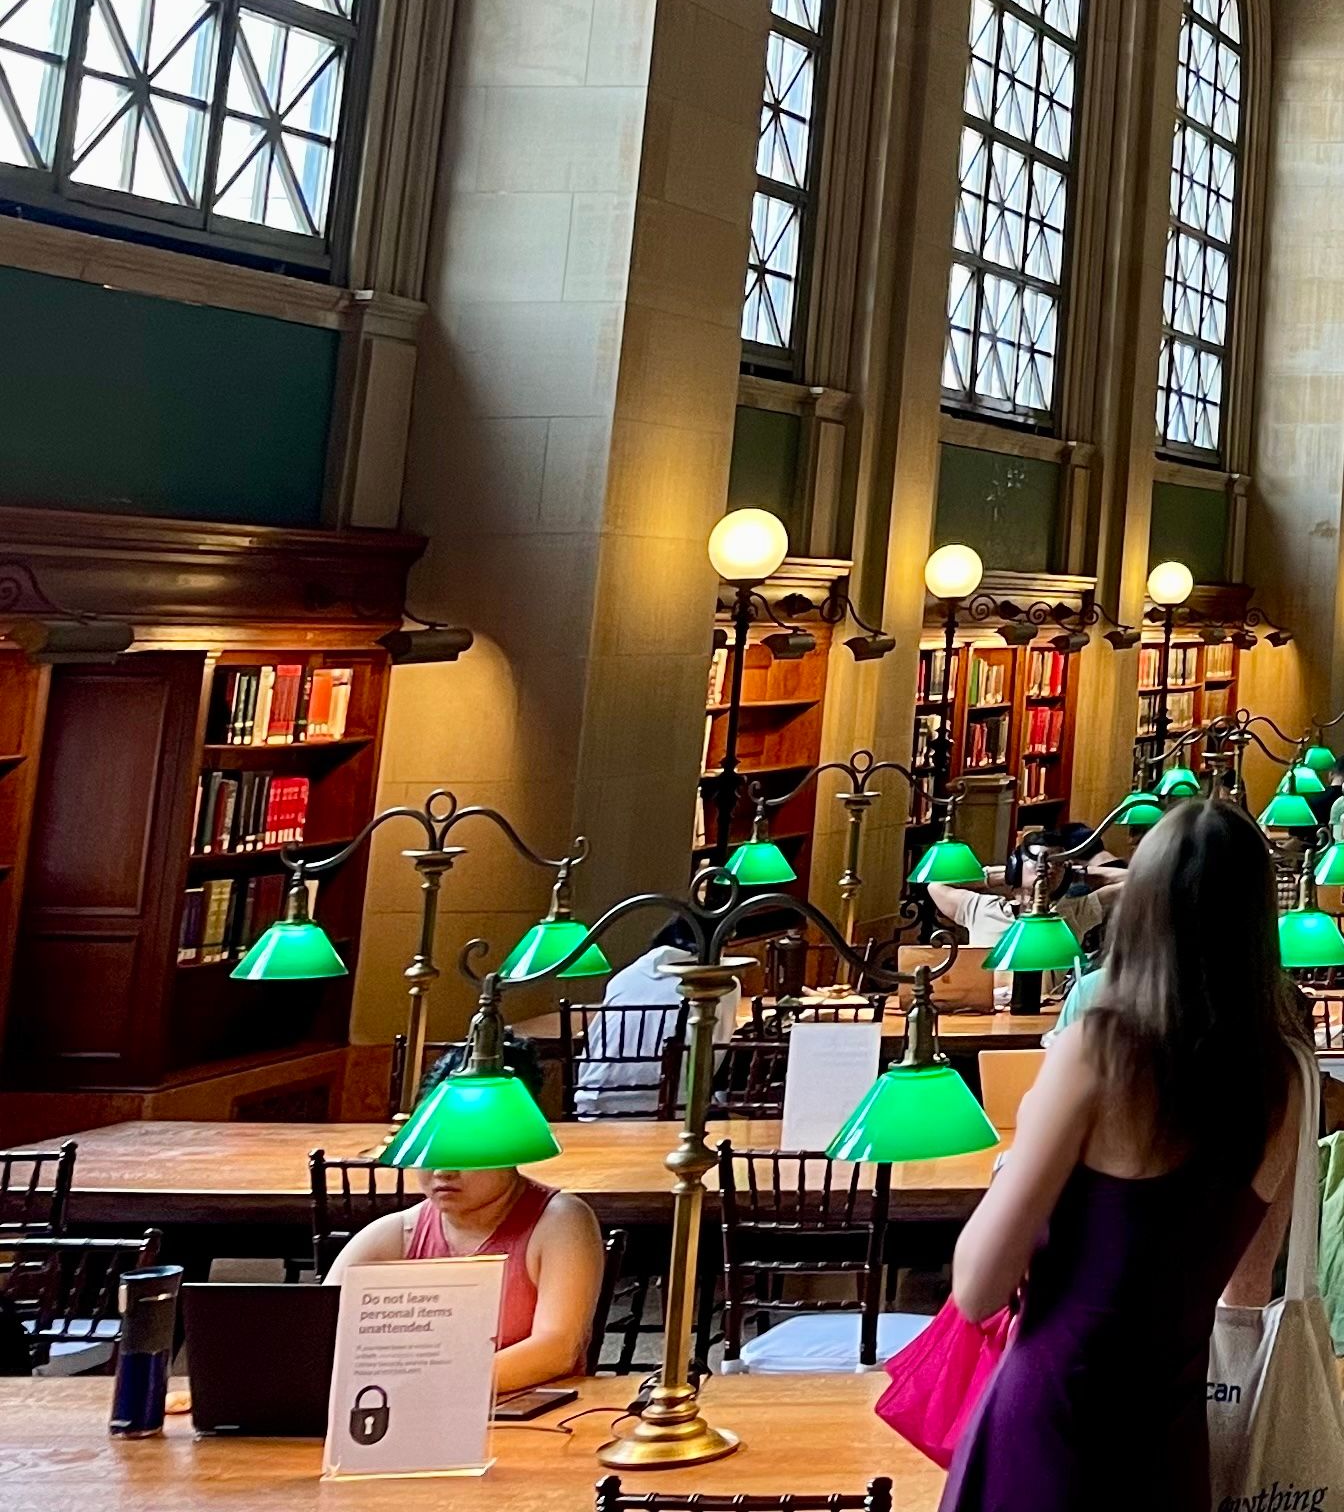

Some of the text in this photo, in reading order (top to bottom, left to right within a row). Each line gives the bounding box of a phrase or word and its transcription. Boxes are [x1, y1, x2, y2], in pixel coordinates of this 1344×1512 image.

[361, 1291, 440, 1306] Do not leave
[359, 1306, 454, 1322] personal items
[358, 1321, 434, 1335] unattended.
